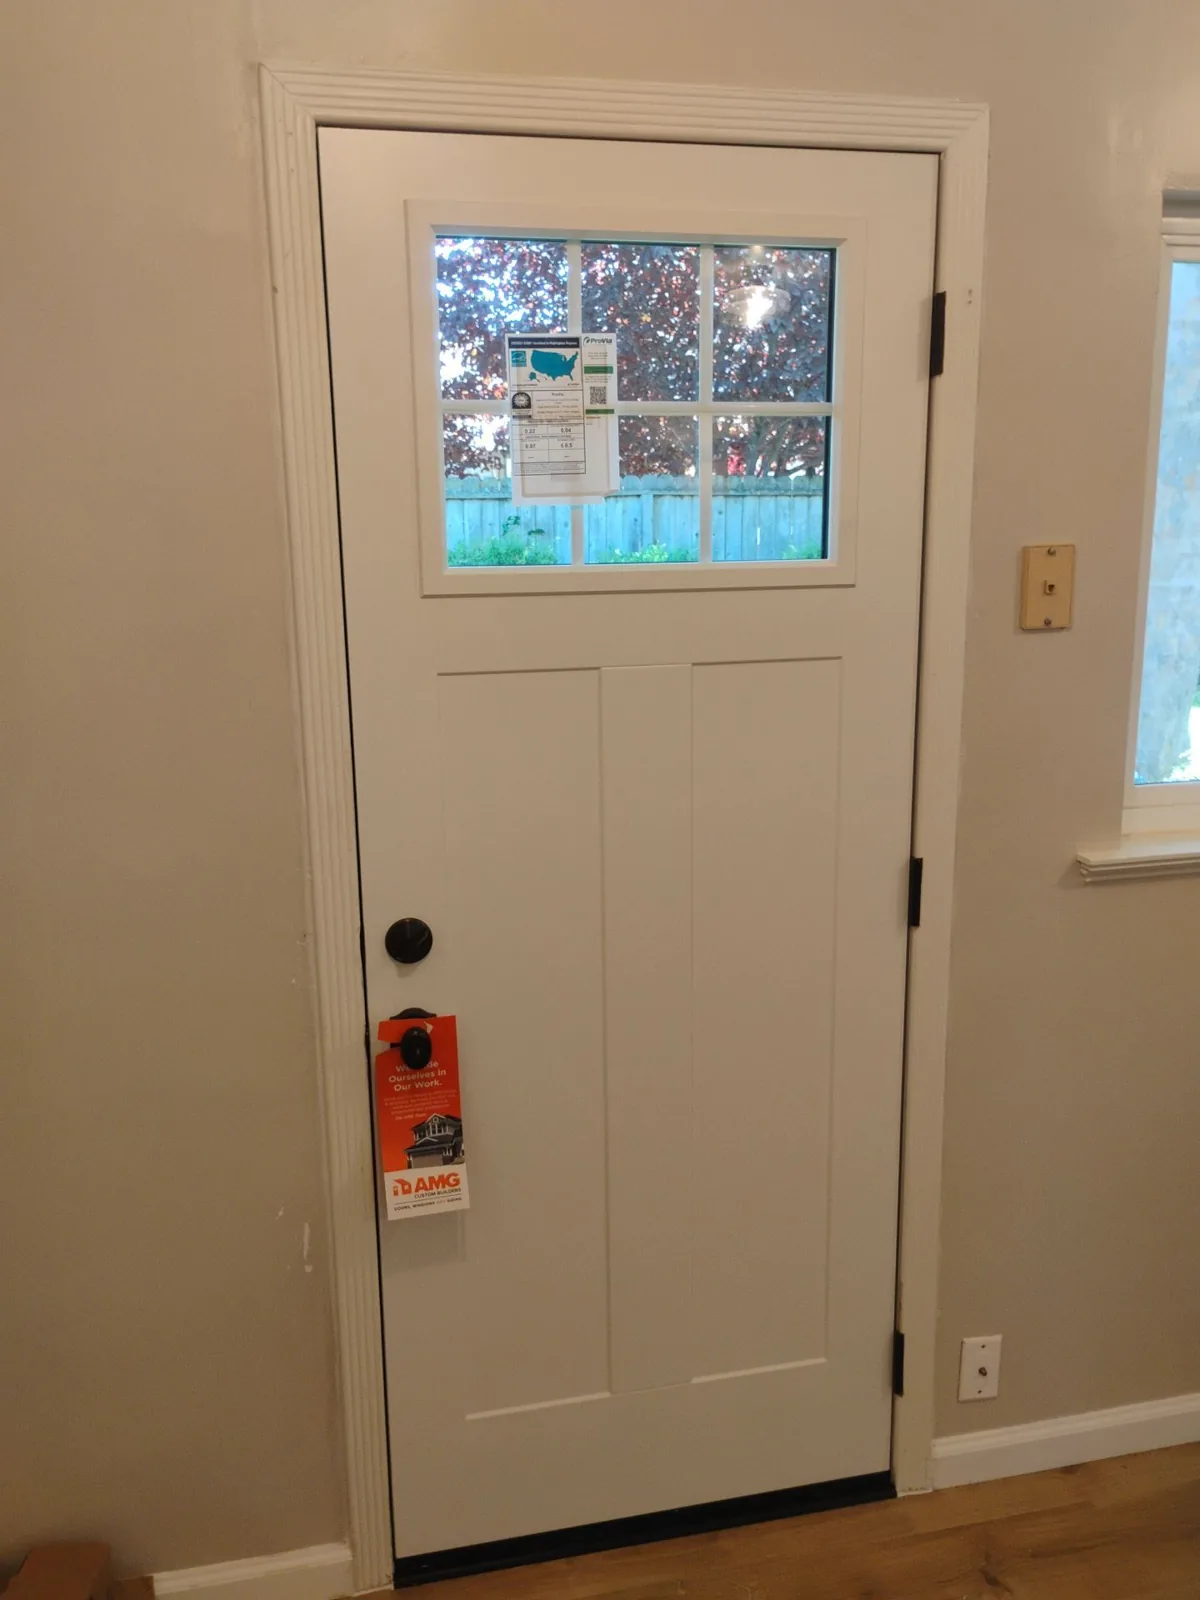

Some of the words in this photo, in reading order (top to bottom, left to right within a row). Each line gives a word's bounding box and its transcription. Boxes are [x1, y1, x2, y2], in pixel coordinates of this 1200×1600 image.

[388, 1070, 435, 1083] Ourselves
[394, 1083, 411, 1091] Our
[414, 1079, 442, 1088] Work.
[414, 1172, 461, 1193] AMG
[414, 1191, 436, 1199] CUSTOM
[437, 1187, 462, 1196] BUILDERS
